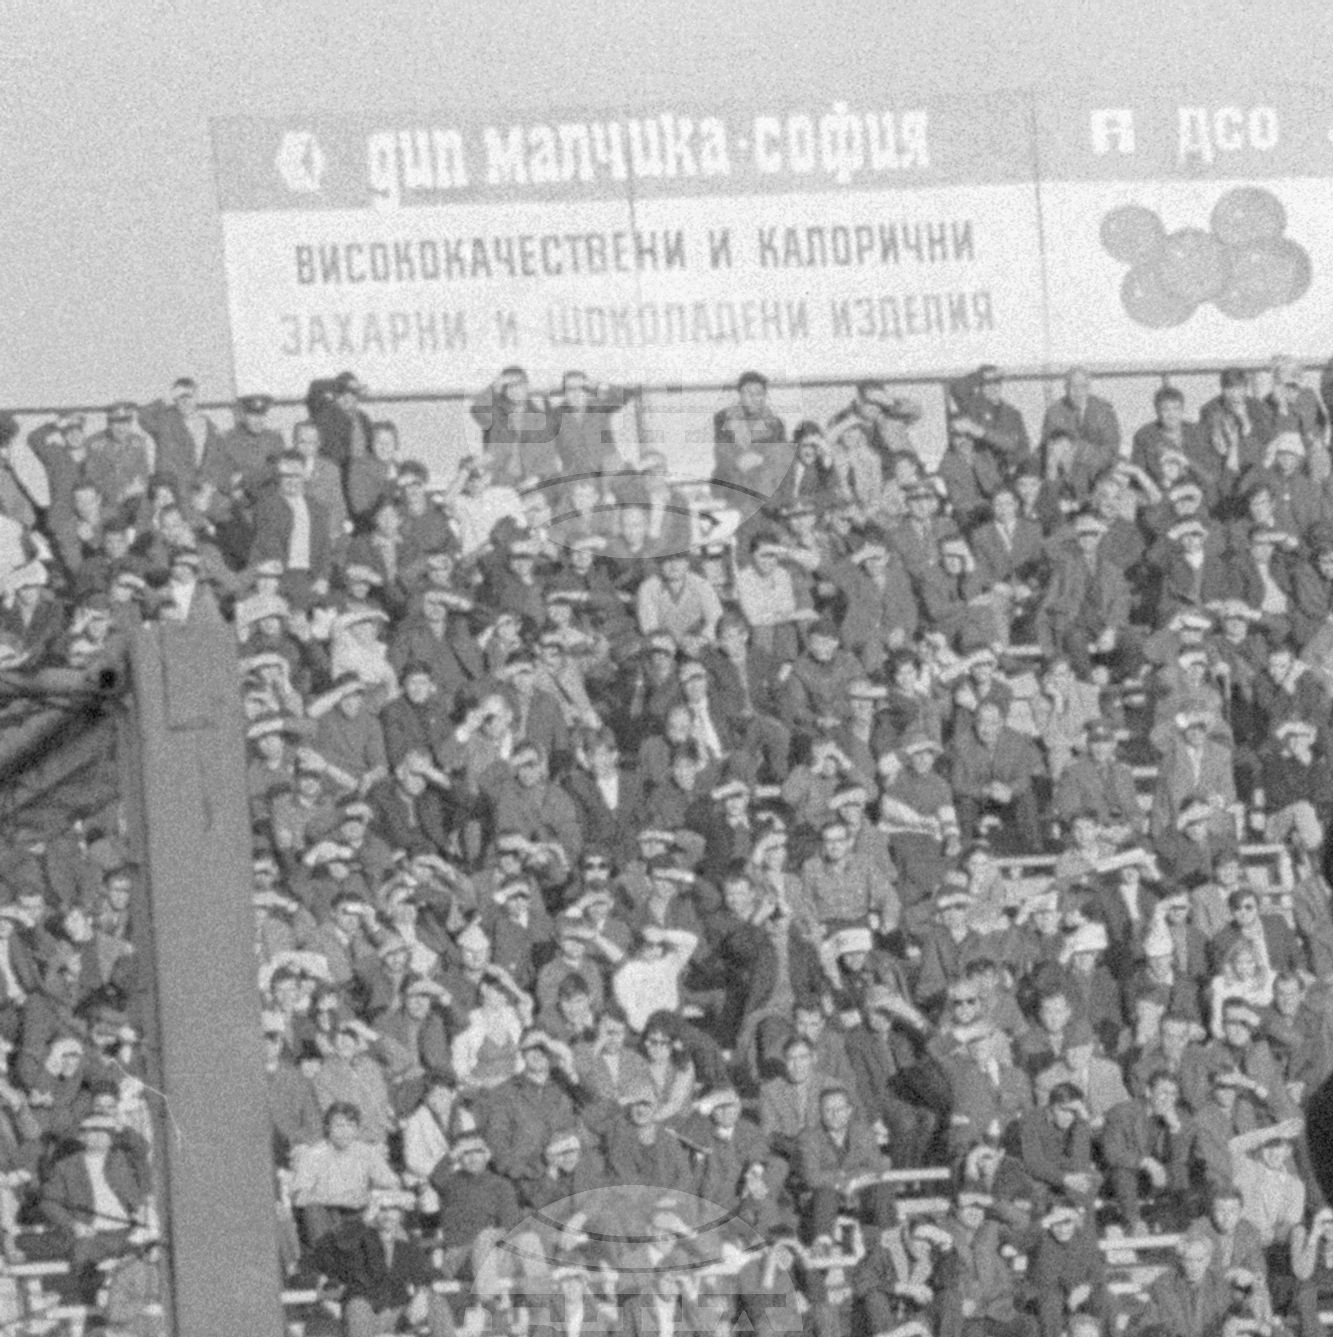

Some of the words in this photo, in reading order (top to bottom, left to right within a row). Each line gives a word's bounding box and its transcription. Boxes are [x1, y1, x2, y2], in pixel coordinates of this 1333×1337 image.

[1177, 105, 1279, 163] ДСО
[296, 229, 687, 286] ВИСОКОКАЧЕСТВЕНИ
[708, 228, 732, 269] И
[280, 310, 468, 356] ЗАХАРНИ
[496, 309, 519, 349] И
